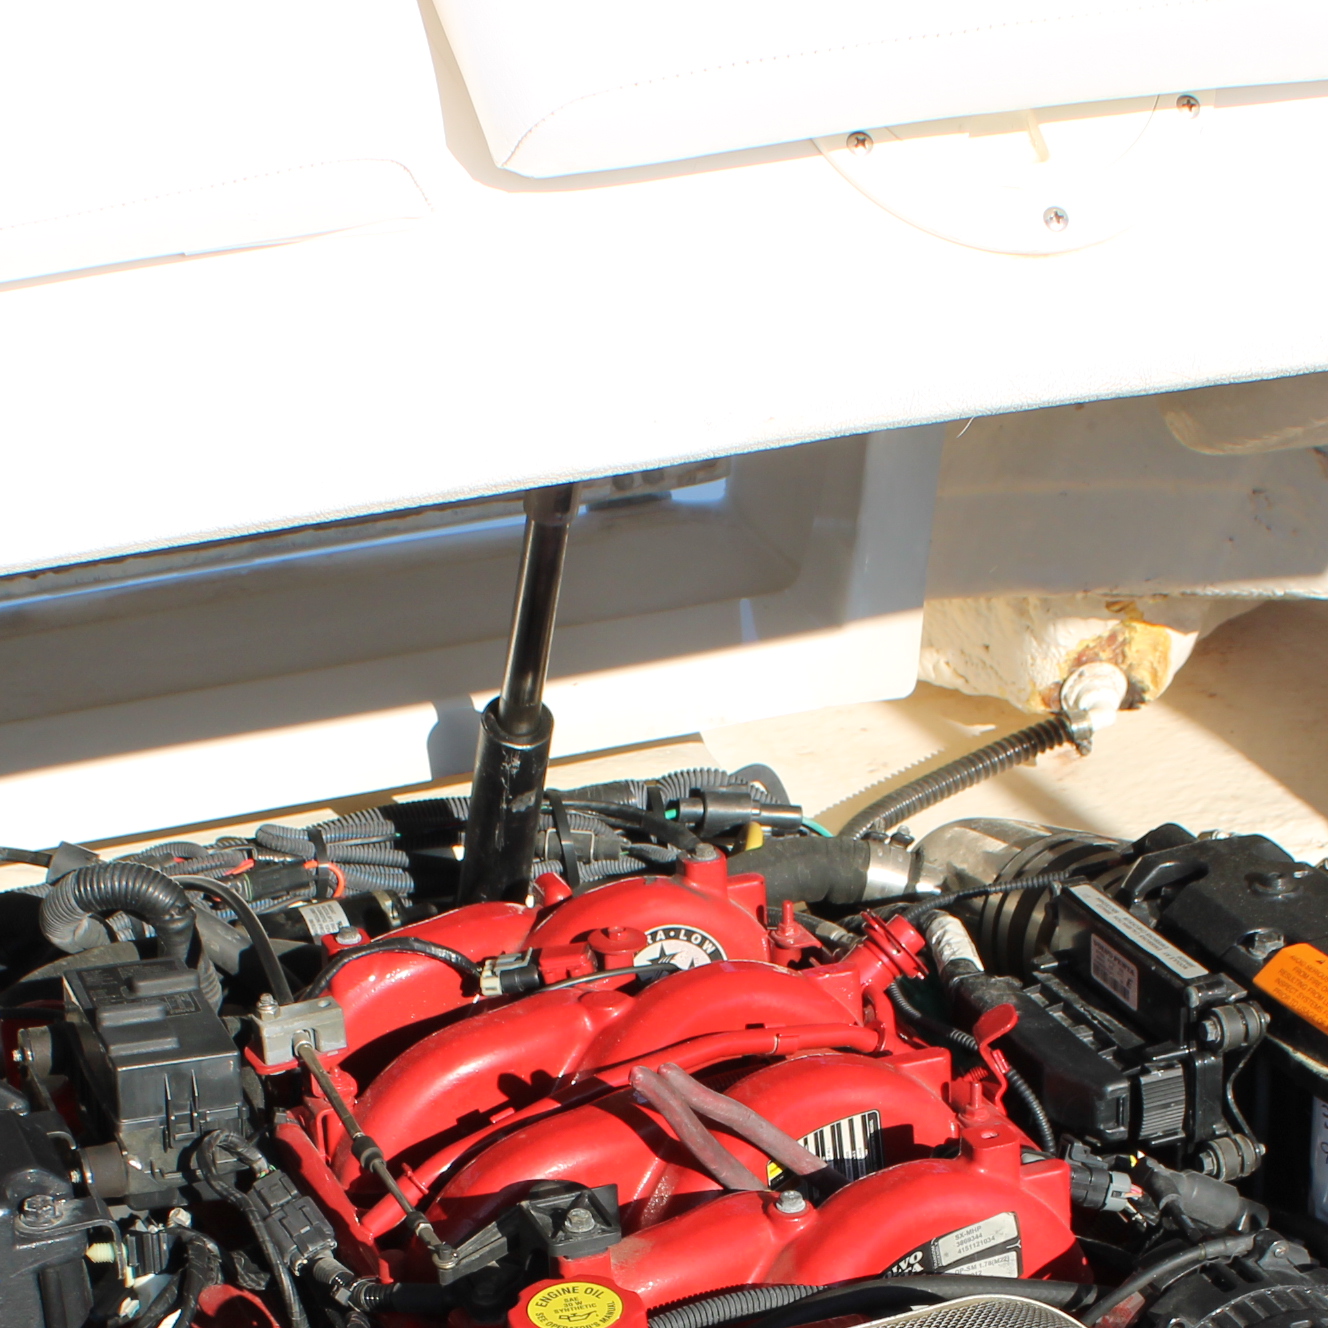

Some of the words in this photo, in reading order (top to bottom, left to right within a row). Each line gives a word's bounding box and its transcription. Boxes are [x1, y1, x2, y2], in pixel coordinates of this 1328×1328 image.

[535, 1286, 580, 1308] ENGINE
[584, 1287, 605, 1299] OIL
[535, 1312, 548, 1323] SEE
[599, 1301, 616, 1324] MANUAL
[554, 1303, 597, 1314] SYNTHETIC
